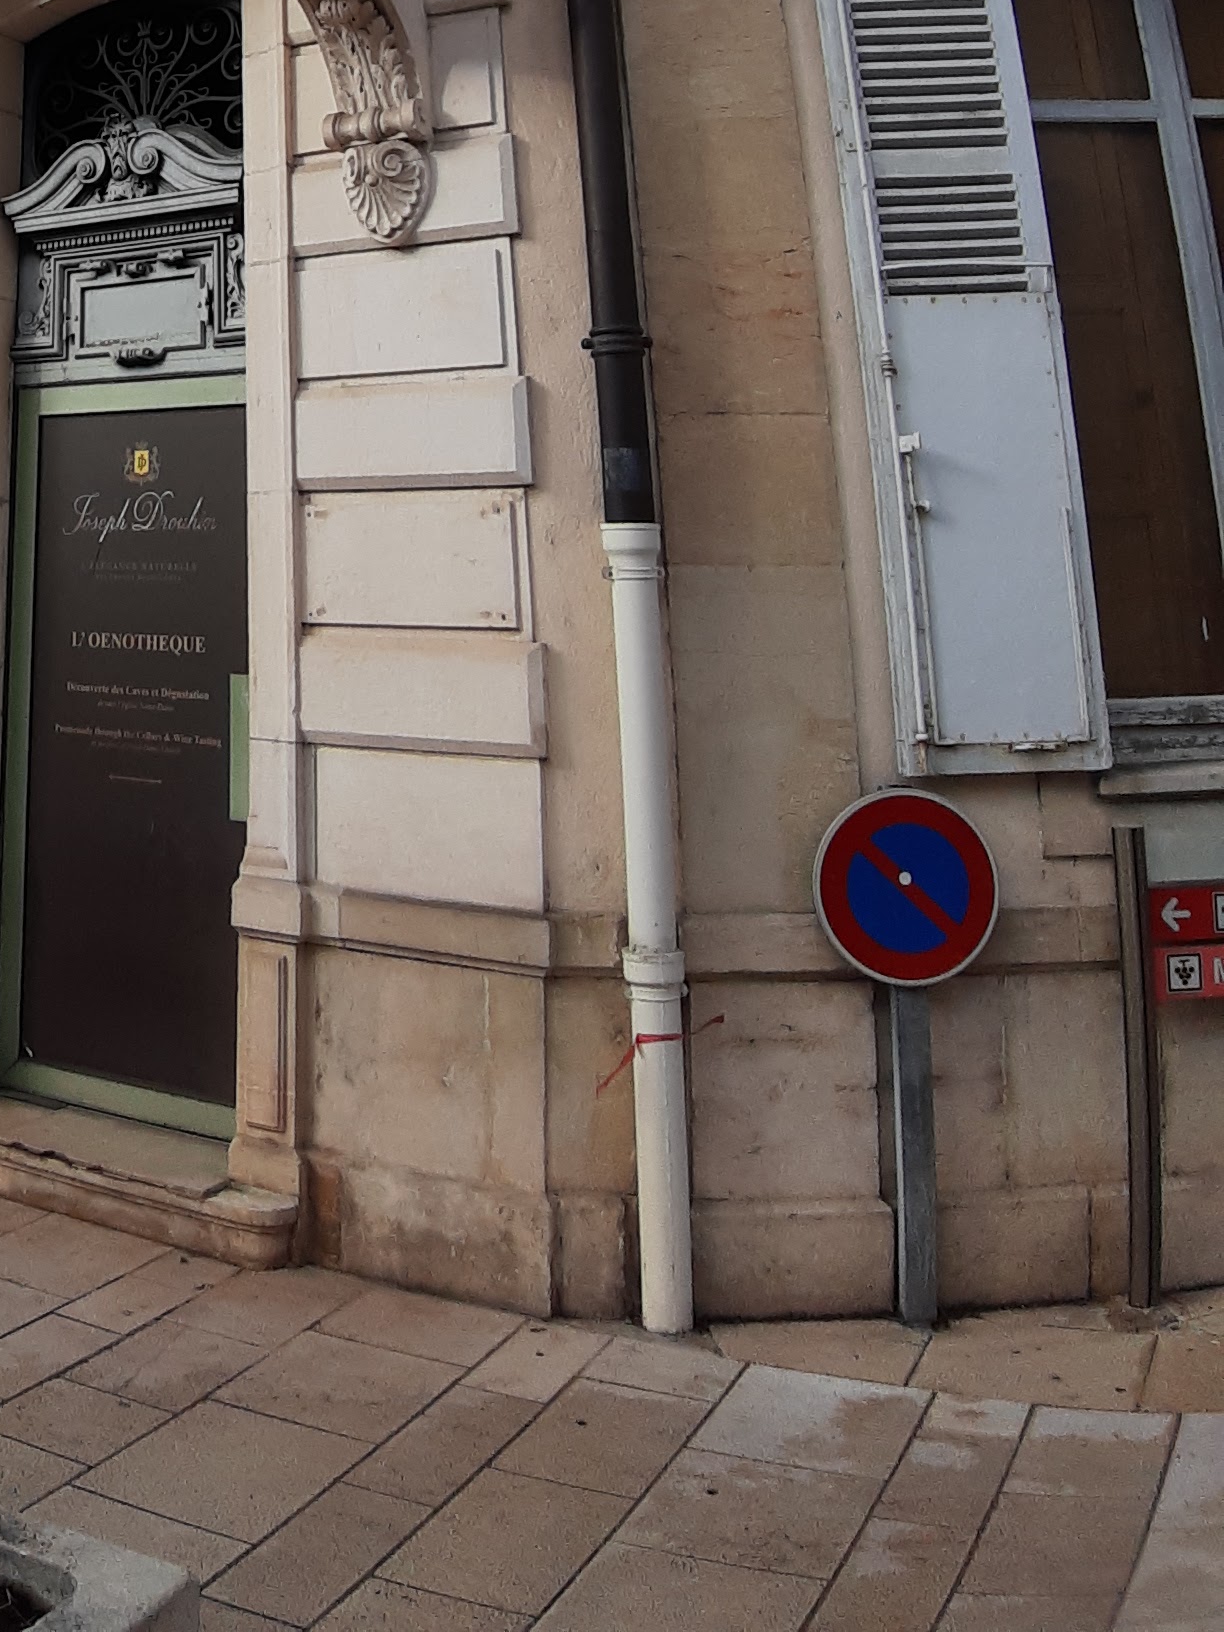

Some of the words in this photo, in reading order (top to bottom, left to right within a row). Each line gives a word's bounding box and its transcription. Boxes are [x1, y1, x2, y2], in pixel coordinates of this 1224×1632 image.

[63, 492, 132, 543] Joseph
[126, 685, 150, 697] Caves
[161, 687, 210, 700] Dégustation
[194, 735, 222, 748] Tasting
